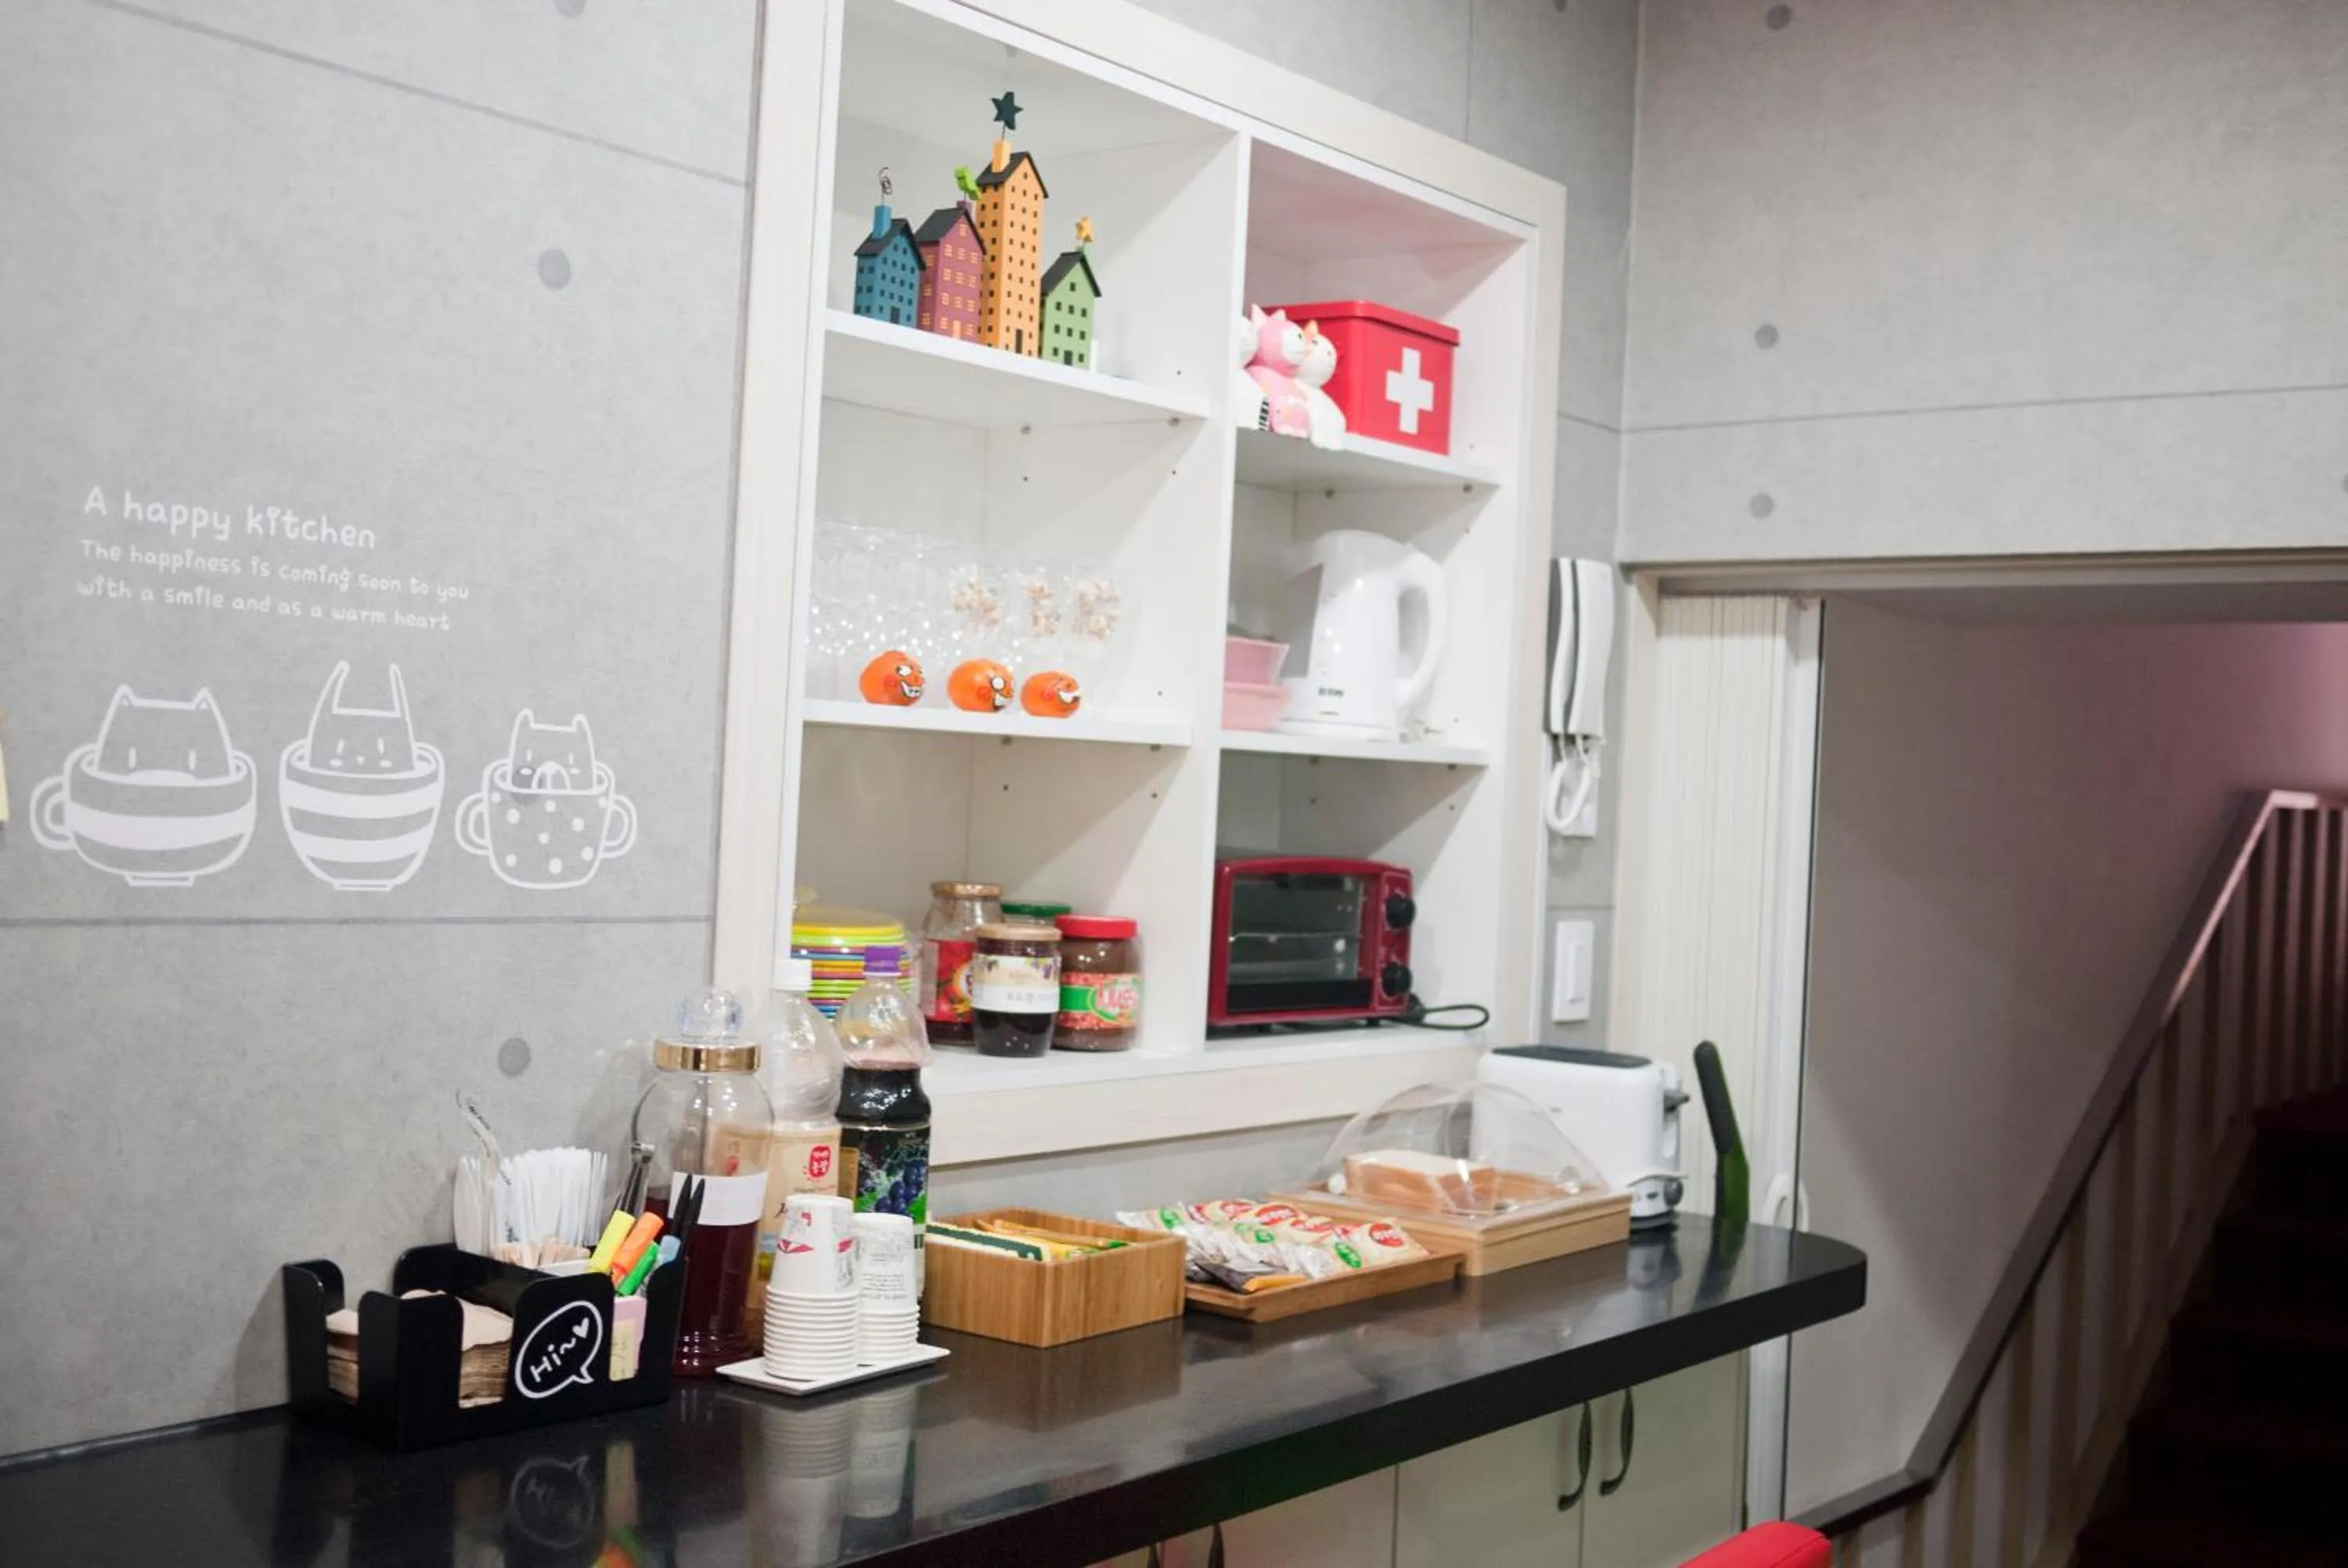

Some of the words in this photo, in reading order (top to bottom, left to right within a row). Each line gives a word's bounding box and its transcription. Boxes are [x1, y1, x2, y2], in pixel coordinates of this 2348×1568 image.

[85, 485, 108, 516] A
[124, 489, 231, 541] happy
[247, 504, 375, 549] kitchen
[77, 575, 131, 599] with
[141, 588, 154, 602] a
[164, 585, 224, 609] smile
[232, 594, 272, 613] and
[278, 601, 302, 617] as
[311, 605, 323, 617] a
[331, 607, 387, 624] warm
[394, 607, 451, 631] heart
[80, 539, 121, 562] The
[131, 544, 242, 575] happiness
[250, 555, 271, 577] is
[279, 563, 351, 592] coming
[358, 573, 402, 592] soon
[409, 574, 429, 595] to
[438, 585, 470, 603] you
